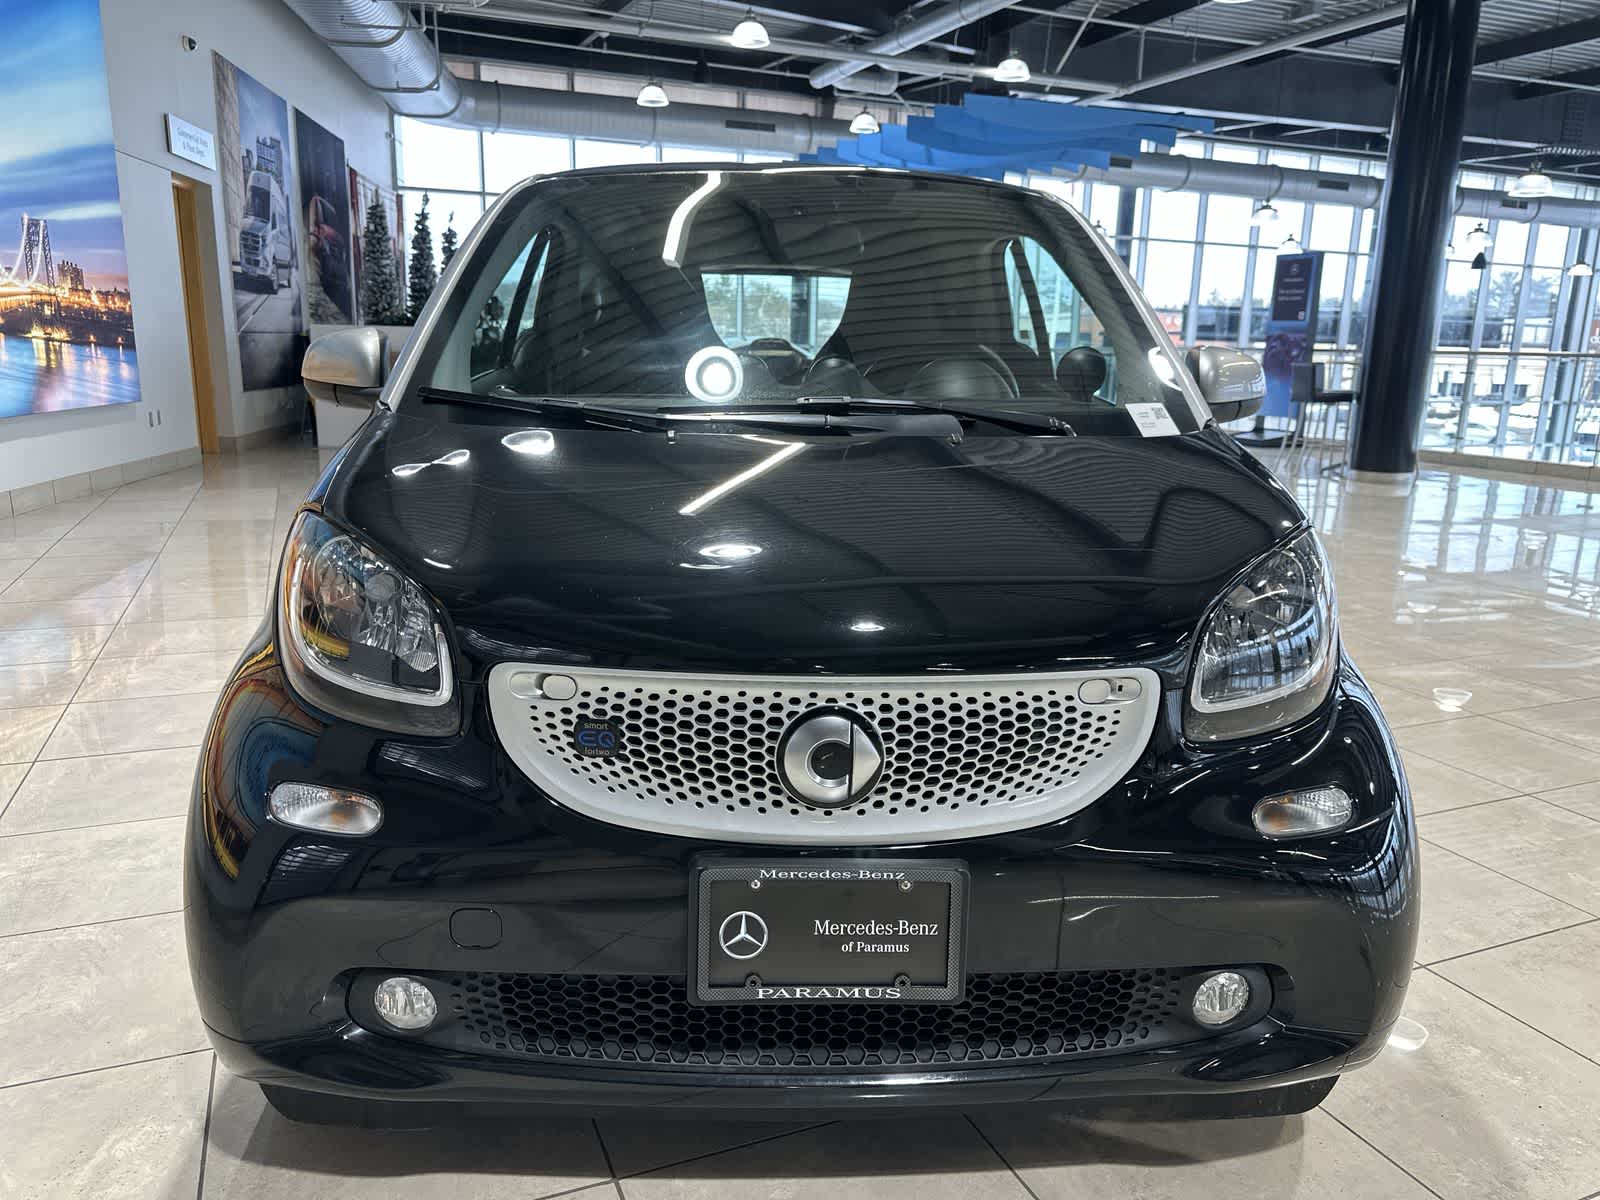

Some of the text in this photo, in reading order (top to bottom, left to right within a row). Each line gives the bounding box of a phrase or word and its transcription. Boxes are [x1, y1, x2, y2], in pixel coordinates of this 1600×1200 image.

[759, 869, 906, 880] Mercedes-Benz
[813, 919, 939, 936] Mercedes-Benz
[841, 941, 910, 953] of Paramus
[756, 987, 902, 999] PARAMUS
